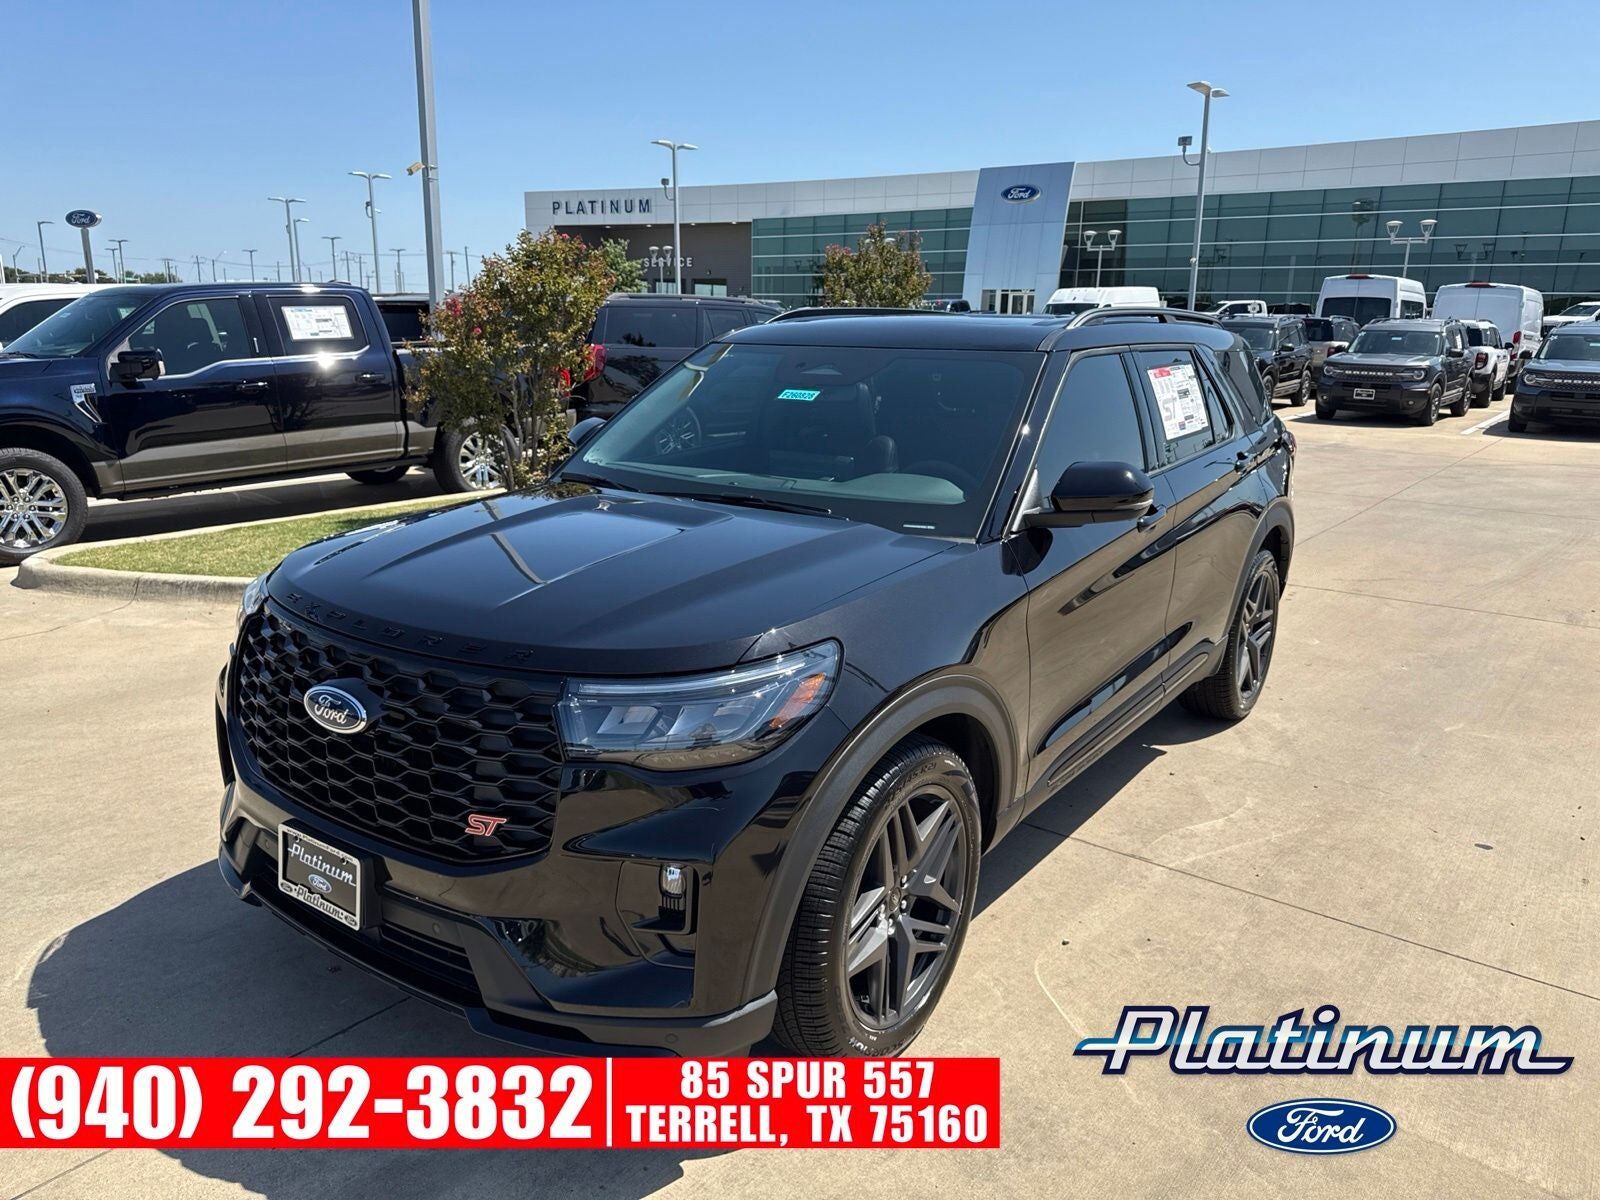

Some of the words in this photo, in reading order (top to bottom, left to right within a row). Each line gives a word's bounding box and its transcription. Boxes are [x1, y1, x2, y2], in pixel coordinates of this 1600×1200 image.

[1008, 187, 1031, 199] Ford
[71, 213, 91, 224] Ford
[552, 199, 651, 215] PLATINUM
[314, 694, 349, 725] Ford
[465, 813, 507, 837] ST
[288, 843, 356, 887] Platinum
[296, 886, 343, 920] Platinum
